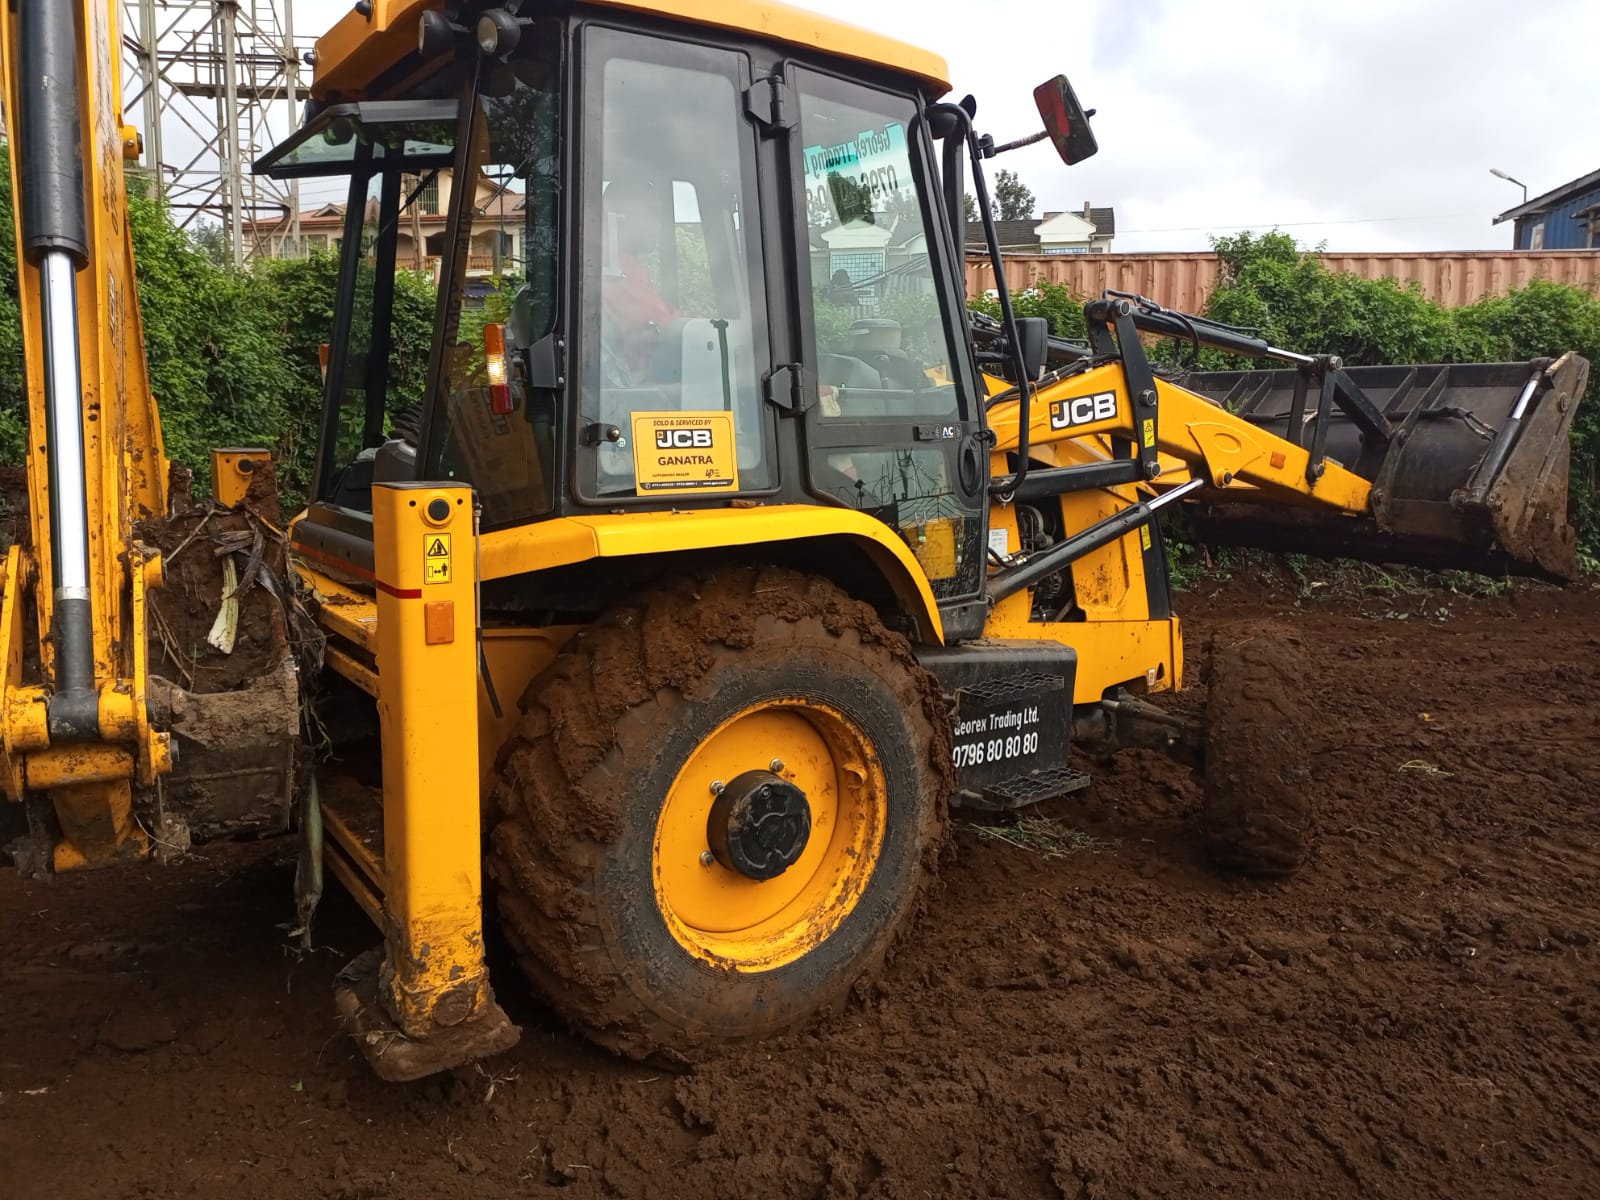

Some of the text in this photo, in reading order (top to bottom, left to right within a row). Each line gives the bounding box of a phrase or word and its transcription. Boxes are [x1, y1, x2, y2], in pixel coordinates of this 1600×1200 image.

[1052, 393, 1116, 428] JCB
[657, 430, 712, 448] JCB
[658, 456, 714, 466] GANATRA
[989, 710, 1022, 730] Trading
[1023, 706, 1040, 724] Ltd.
[952, 732, 1038, 768] 0796 80 80 80
